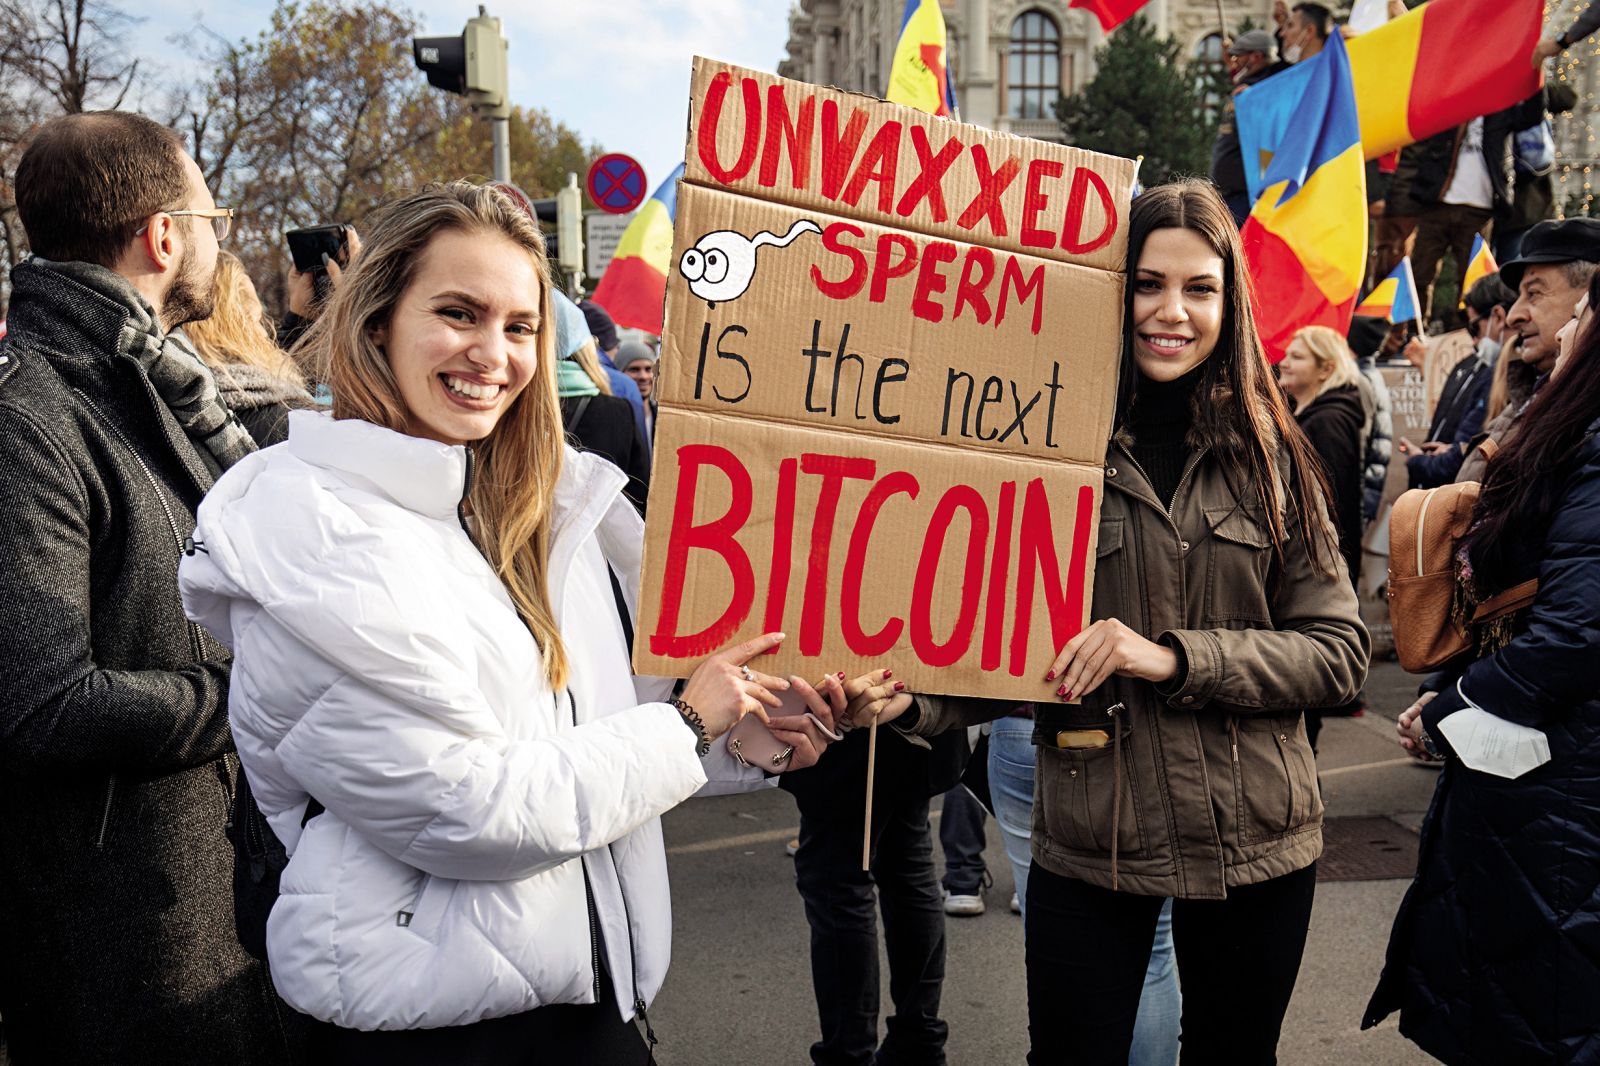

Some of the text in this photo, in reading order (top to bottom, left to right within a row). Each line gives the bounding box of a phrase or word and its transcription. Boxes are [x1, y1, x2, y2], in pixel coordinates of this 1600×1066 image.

[699, 71, 1118, 255] UNVAXXED
[810, 222, 1046, 336] SPERM
[801, 319, 910, 425] the
[940, 360, 1065, 448] next
[649, 443, 1095, 678] BITCOIN
